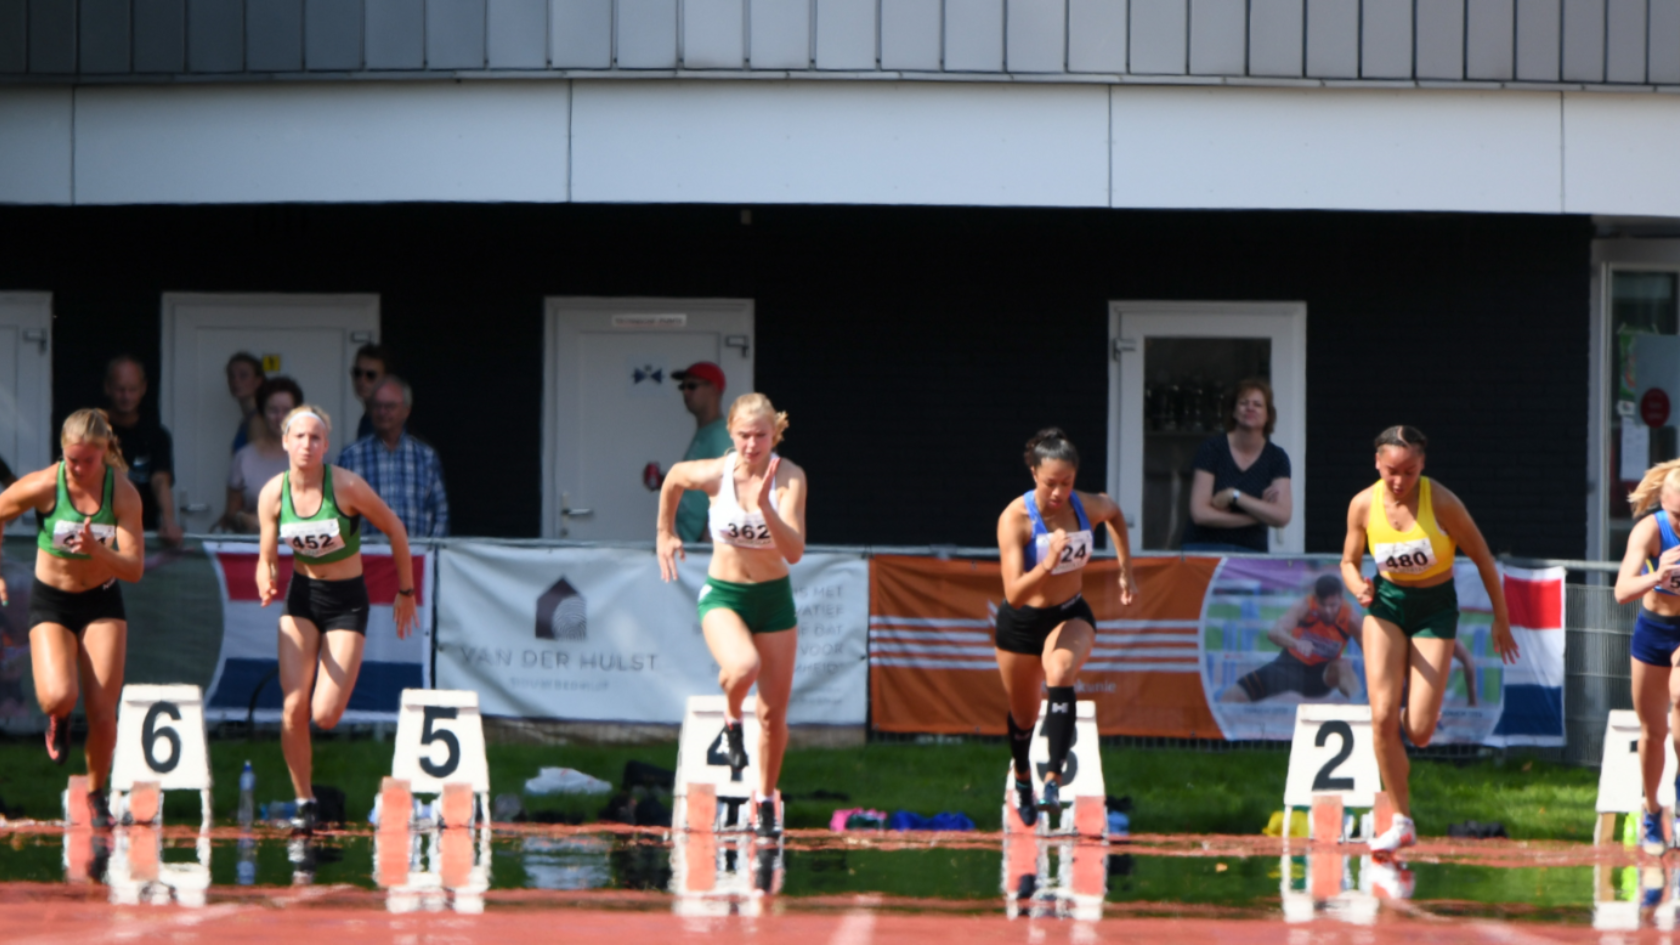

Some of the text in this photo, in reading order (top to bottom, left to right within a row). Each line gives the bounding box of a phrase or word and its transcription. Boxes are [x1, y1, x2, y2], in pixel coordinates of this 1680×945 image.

[292, 533, 334, 549] 452
[728, 522, 770, 540] 362
[1061, 543, 1087, 563] 24
[1385, 551, 1428, 568] 480
[813, 586, 844, 598] MET
[1670, 576, 1680, 589] 5
[461, 647, 659, 671] VAN DER HULST
[801, 643, 844, 657] VOOR
[141, 700, 182, 774] 6
[419, 706, 461, 779] 5
[706, 721, 750, 782] 4
[1036, 717, 1078, 788] 3
[1311, 719, 1355, 792] 2
